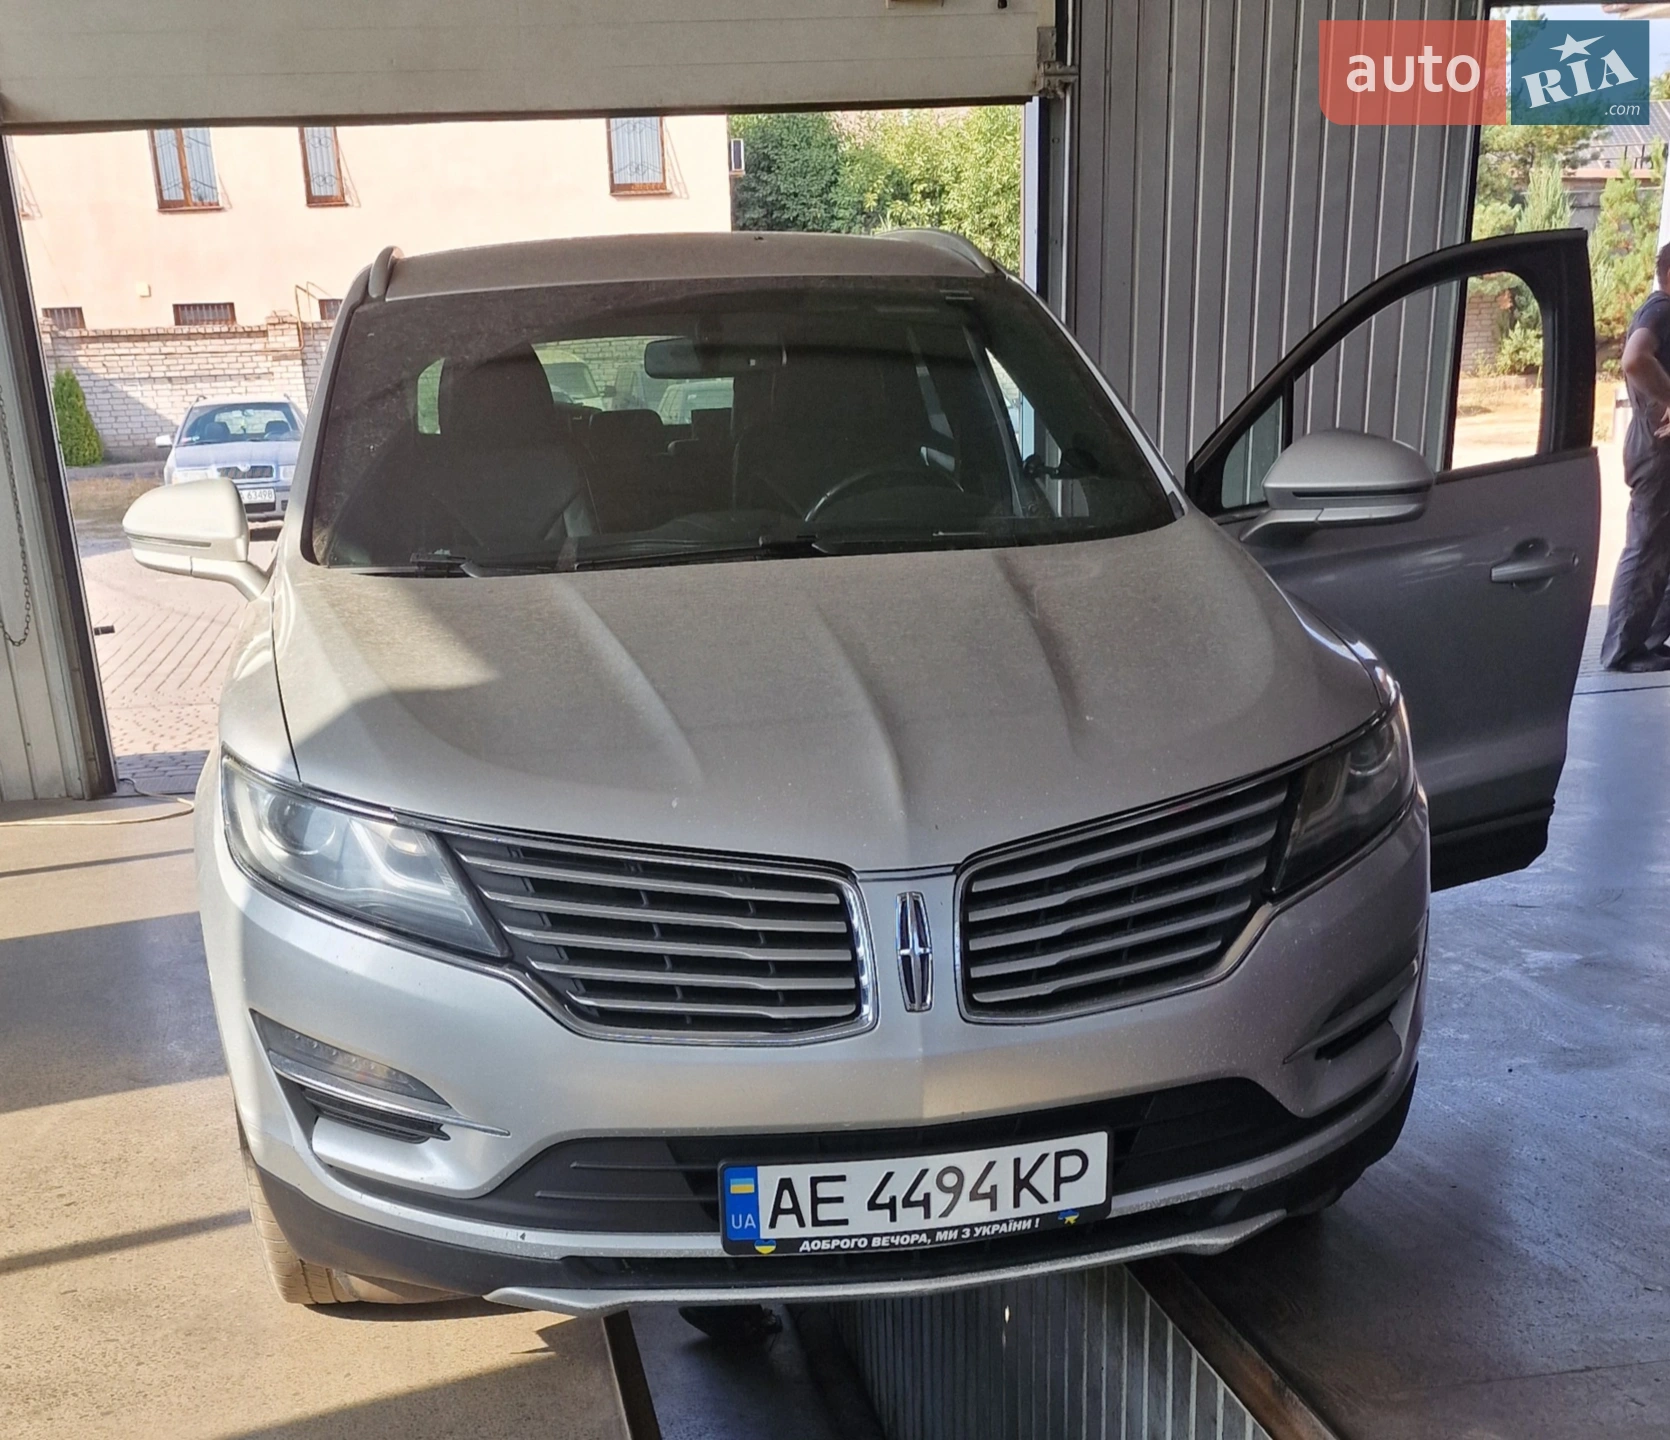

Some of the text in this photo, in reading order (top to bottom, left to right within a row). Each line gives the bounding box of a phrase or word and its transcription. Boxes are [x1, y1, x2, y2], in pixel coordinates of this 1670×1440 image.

[247, 490, 273, 500] 63498
[768, 1148, 1089, 1229] AE 4494 KP
[731, 1213, 757, 1230] UA
[799, 1237, 868, 1253] ДОБРОГО
[871, 1233, 932, 1248] ВЕЧОРА,
[935, 1229, 958, 1242] МИ
[973, 1219, 1033, 1238] УКРАЇНИ
